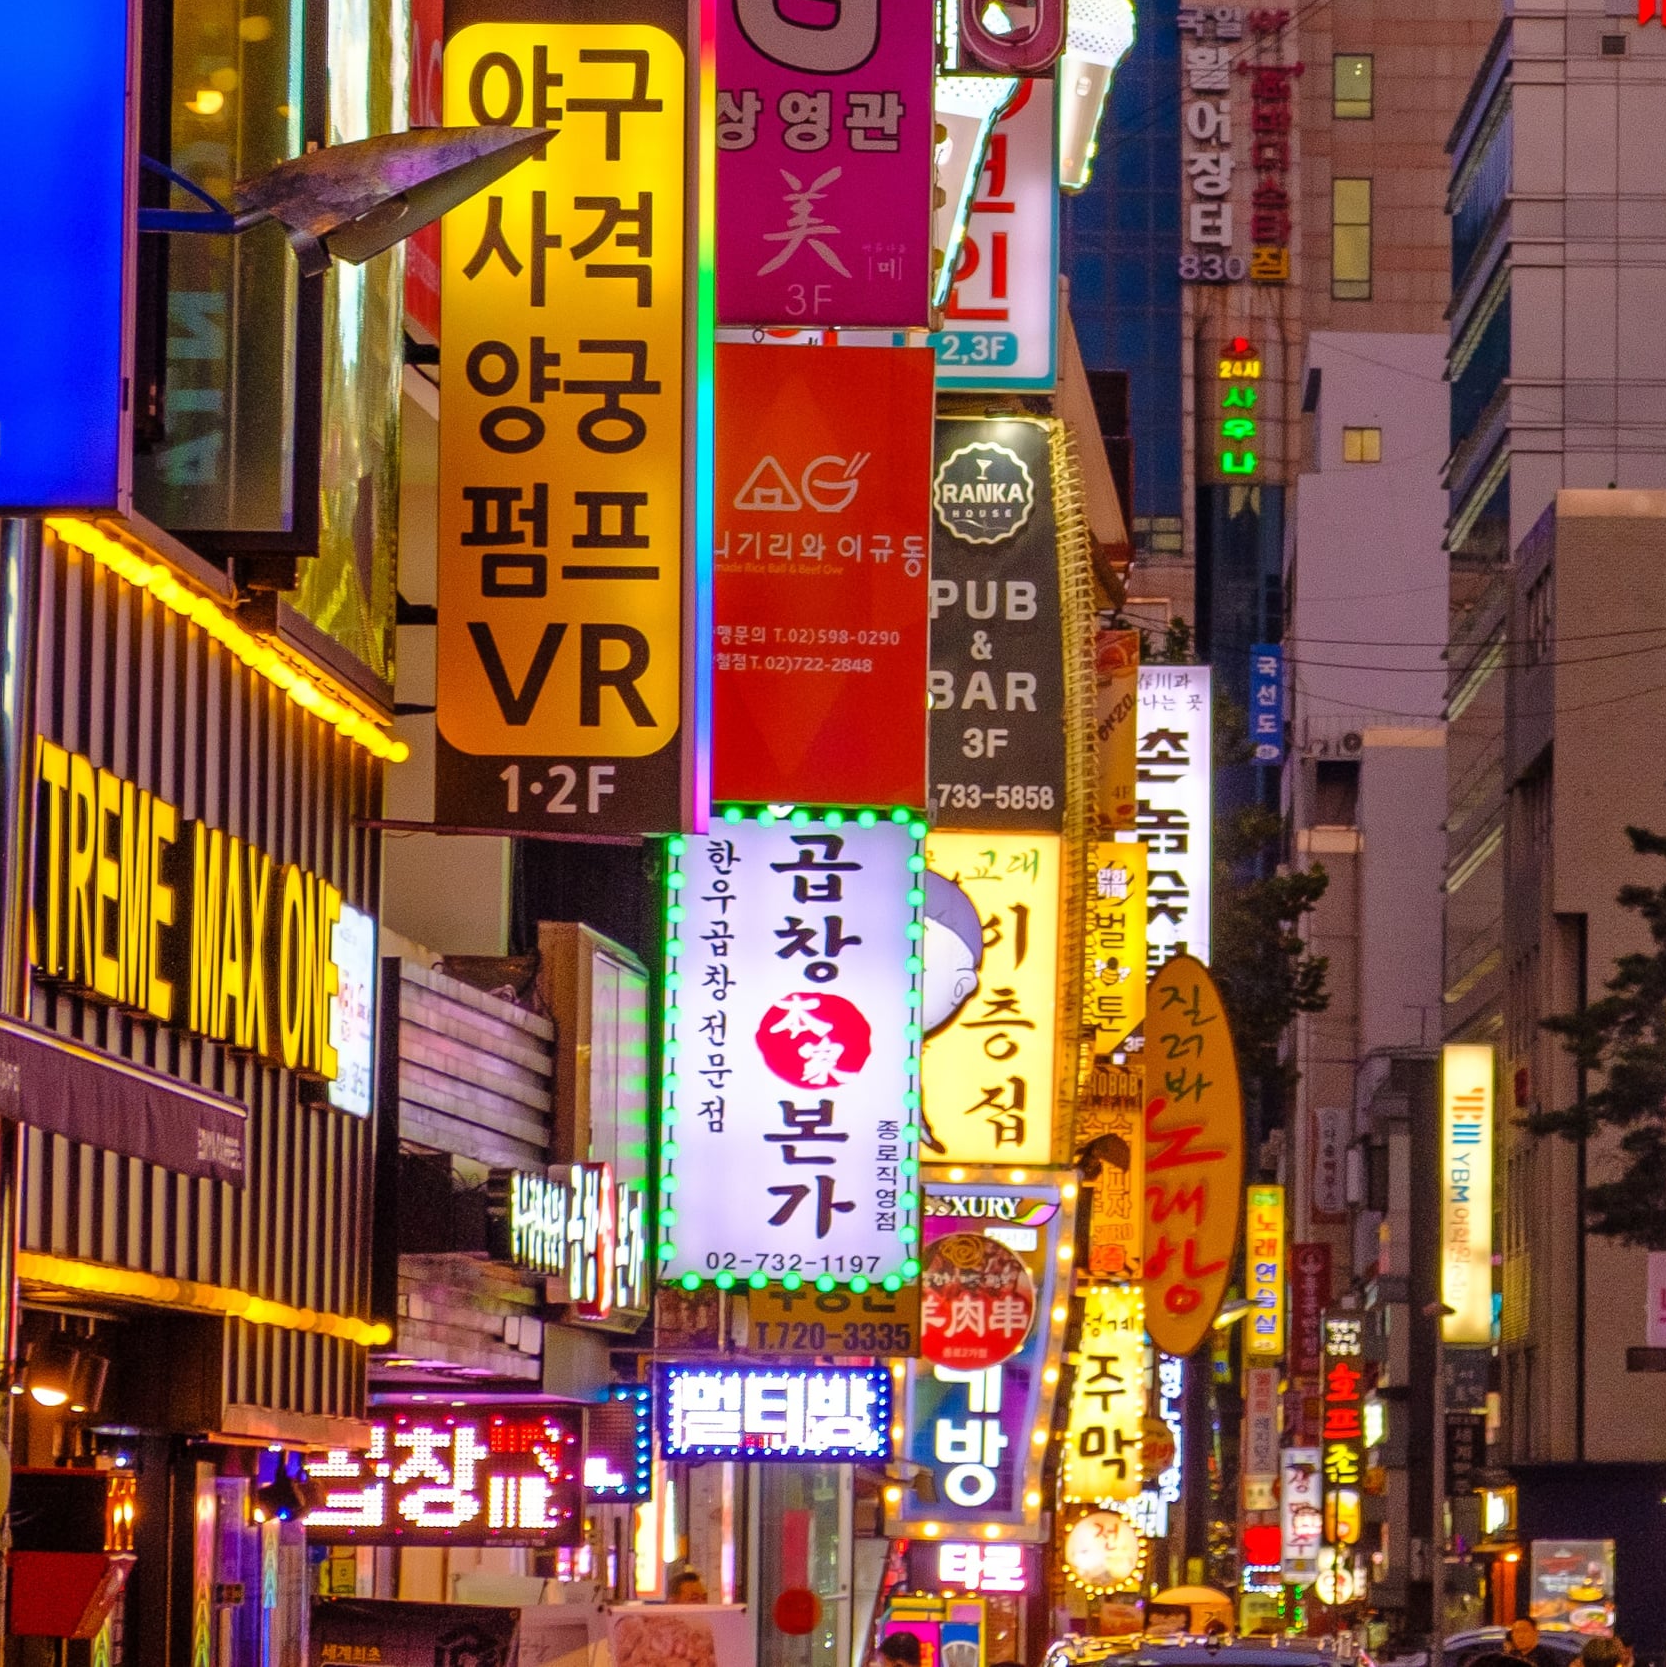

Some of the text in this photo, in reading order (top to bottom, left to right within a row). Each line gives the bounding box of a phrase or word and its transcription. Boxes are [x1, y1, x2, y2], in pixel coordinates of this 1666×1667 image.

[717, 90, 904, 153] 상영관
[462, 190, 655, 309] 사격
[757, 166, 852, 278] 美
[784, 283, 833, 317] 3F
[465, 336, 662, 454] 양궁
[1220, 386, 1257, 476] 사우나
[941, 481, 1025, 505] RANKA
[952, 508, 1013, 519] HOUSE
[460, 482, 660, 599] 펌프
[837, 533, 927, 579] 이규동
[930, 580, 1038, 621] PUB
[970, 631, 993, 660] &
[466, 621, 658, 728] VR
[929, 671, 1038, 712] BAR
[961, 728, 1009, 759] 3F
[937, 784, 1055, 810] 733-5858
[769, 834, 864, 983] 곱창
[190, 819, 272, 1056] MAX
[279, 863, 341, 1082] ONE
[962, 903, 1036, 1148] 이층집
[875, 1120, 900, 1232] 종로직영점
[706, 1252, 882, 1273] 02-732-1197
[1079, 1354, 1138, 1481] 주막
[938, 1542, 1027, 1592] 타로
[320, 1643, 382, 1663] 세계최초
